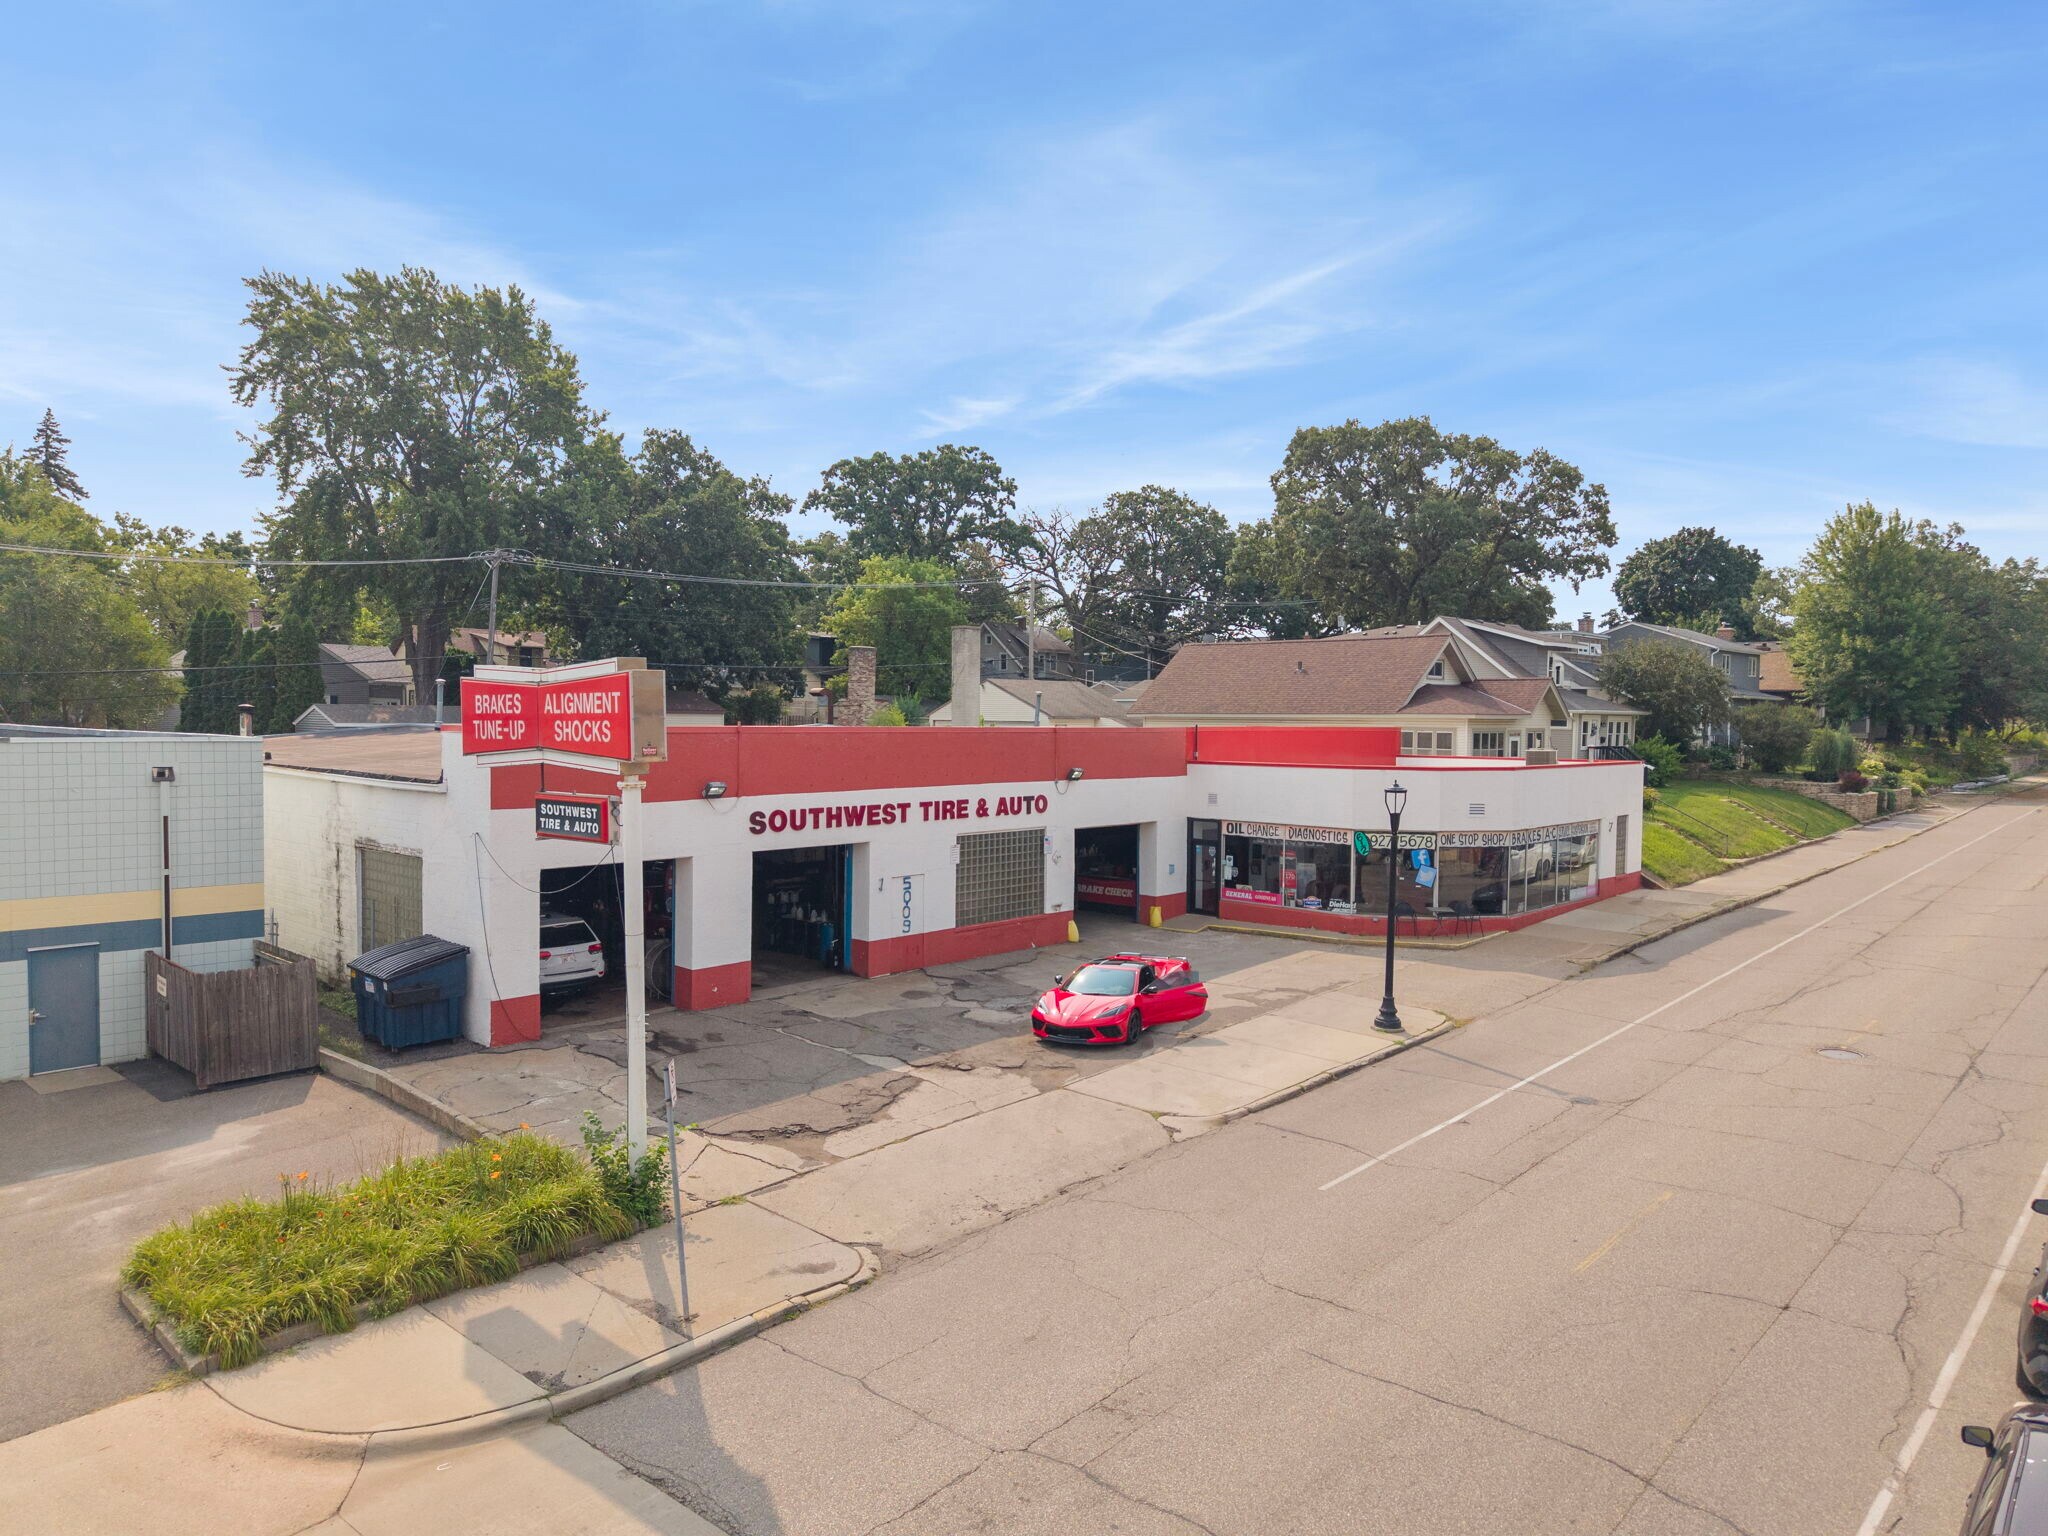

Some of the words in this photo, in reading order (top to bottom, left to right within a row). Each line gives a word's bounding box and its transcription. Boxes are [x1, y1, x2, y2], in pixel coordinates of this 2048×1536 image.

[475, 693, 522, 714] BRAKES
[544, 691, 621, 714] ALIGNMENT
[473, 720, 525, 740] TUNE-UP
[554, 719, 612, 743] SHOCKS
[540, 803, 597, 819] SOUTHWEST
[749, 802, 911, 835] SOUTHWEST
[919, 798, 969, 821] TIRE
[975, 797, 989, 818] &
[996, 794, 1048, 817] AUTO
[540, 817, 561, 830] TIRE
[564, 819, 570, 831] &
[573, 821, 599, 834] AUTO
[1226, 822, 1244, 835] OIL
[1246, 823, 1280, 837] CHANGE
[1288, 826, 1348, 844] DIAGNOSTICS
[1371, 834, 1392, 848] 927
[1399, 834, 1434, 849] 5678
[1440, 833, 1456, 846] ONE
[1458, 833, 1479, 846] STOP
[1483, 833, 1508, 846] SHOP!
[1512, 829, 1541, 845] BRAKES
[1356, 833, 1369, 855] 612
[1077, 883, 1104, 895] BRAKE
[1104, 887, 1134, 898] CHECK
[1225, 890, 1252, 900] GENERAL
[902, 875, 912, 933] 5009
